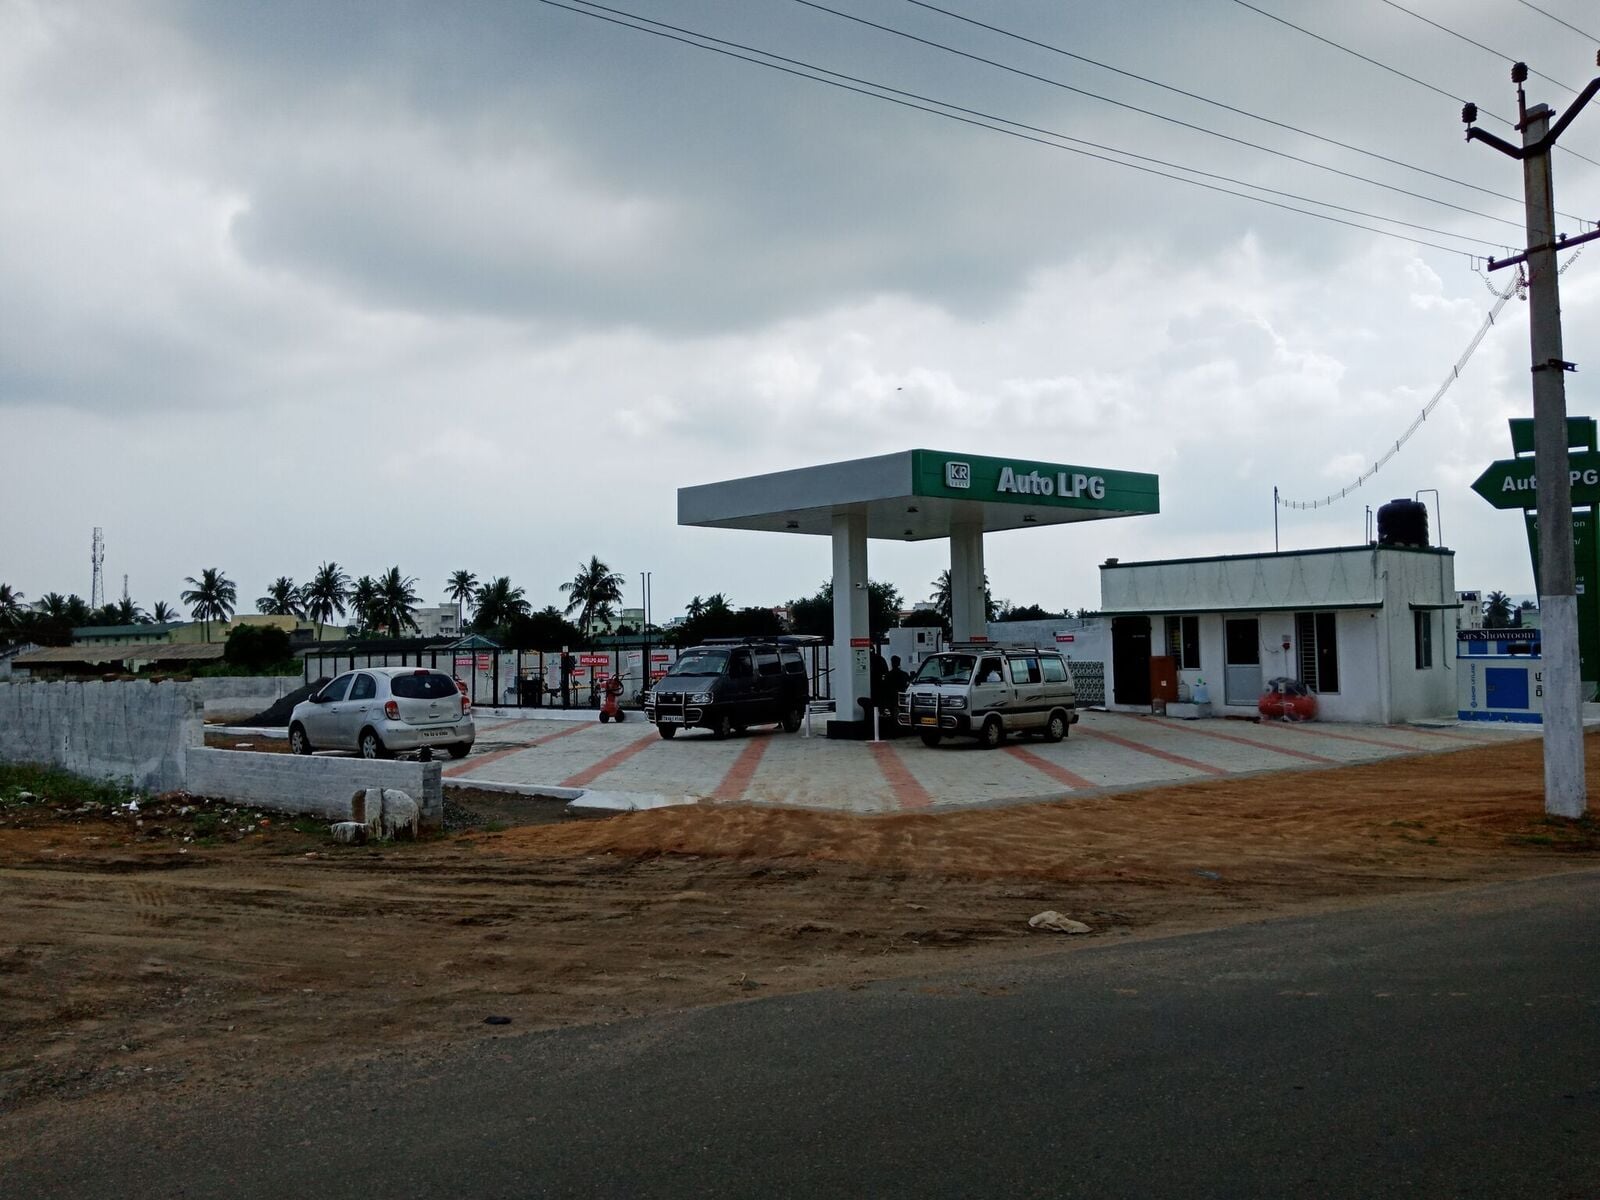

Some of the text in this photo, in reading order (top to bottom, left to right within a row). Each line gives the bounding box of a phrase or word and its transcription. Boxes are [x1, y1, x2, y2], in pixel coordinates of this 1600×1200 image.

[951, 465, 968, 480] KR
[1502, 469, 1599, 492] Aut PG
[997, 466, 1105, 500] Auto LPG
[1479, 630, 1535, 641] Showroom
